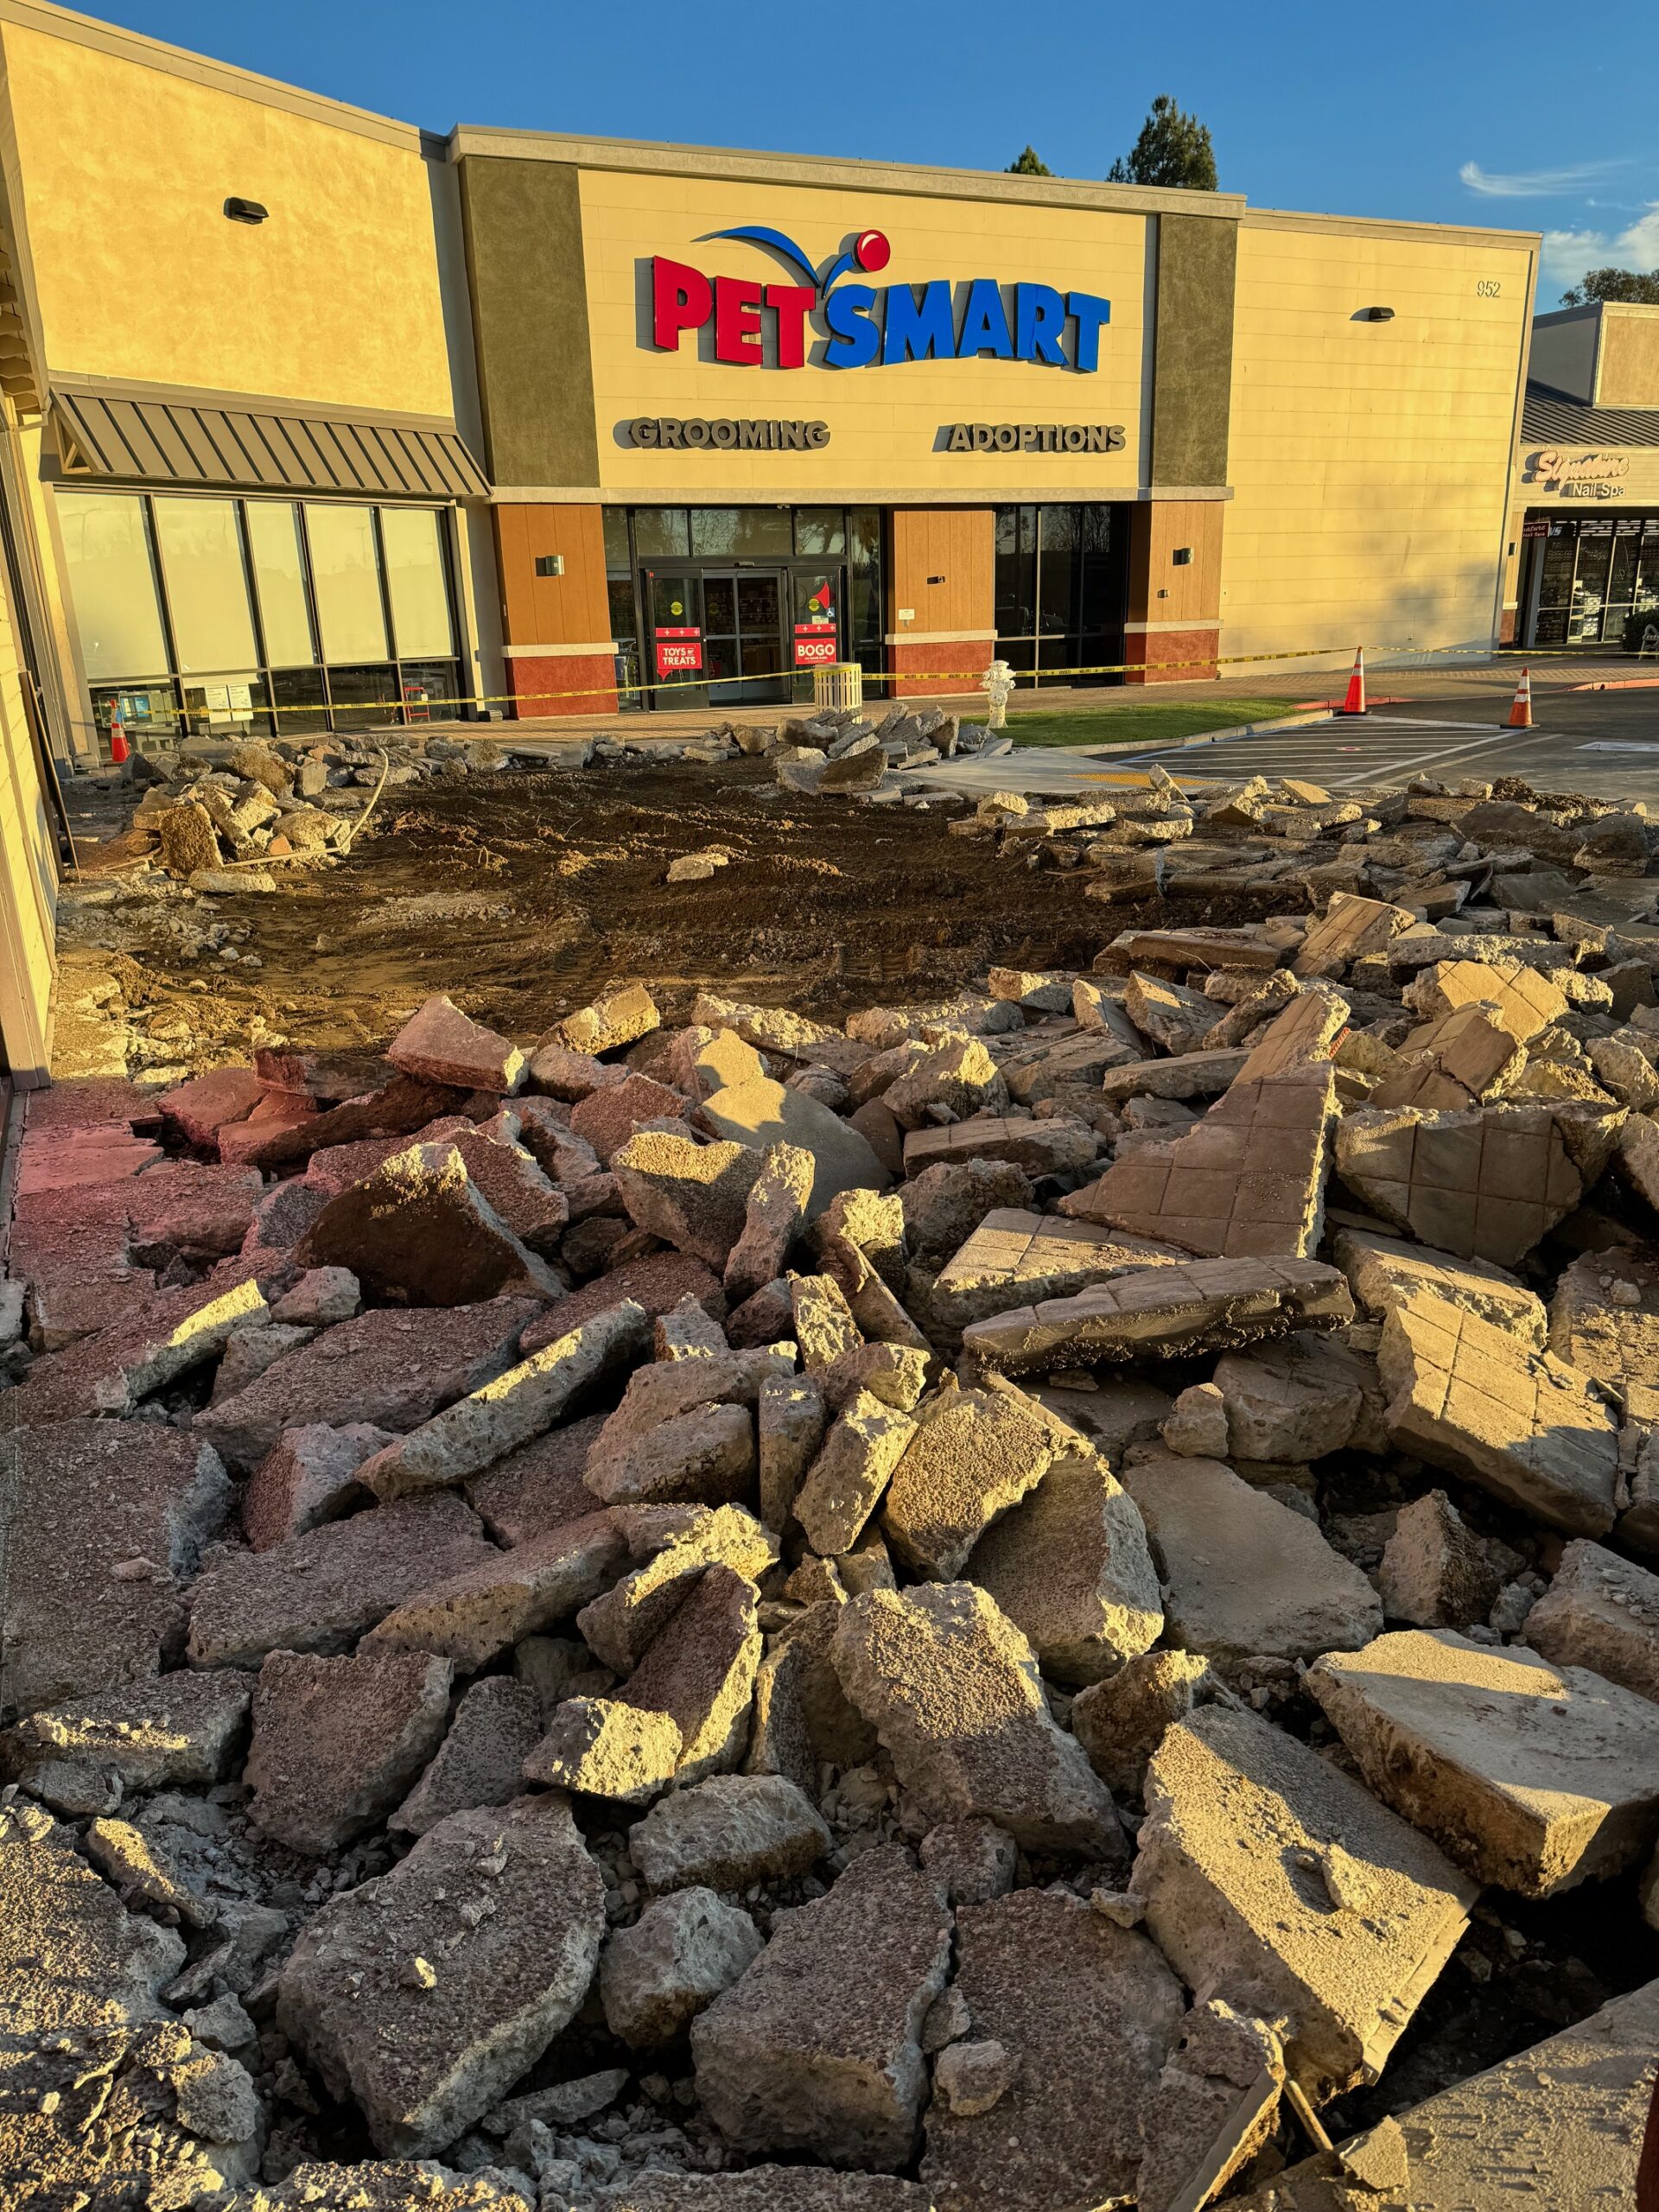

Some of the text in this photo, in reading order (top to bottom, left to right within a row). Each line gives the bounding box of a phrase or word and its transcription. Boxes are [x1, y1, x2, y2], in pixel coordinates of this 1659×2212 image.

[1477, 280, 1501, 298] 952
[652, 255, 1111, 373] PETSMART
[630, 417, 831, 450] GROOMING
[949, 423, 1127, 453] ADOPTIONS
[1573, 483, 1625, 499] Nail Spa
[663, 647, 686, 657] TOYS
[798, 643, 835, 657] BOGO
[662, 656, 696, 665] TREATS
